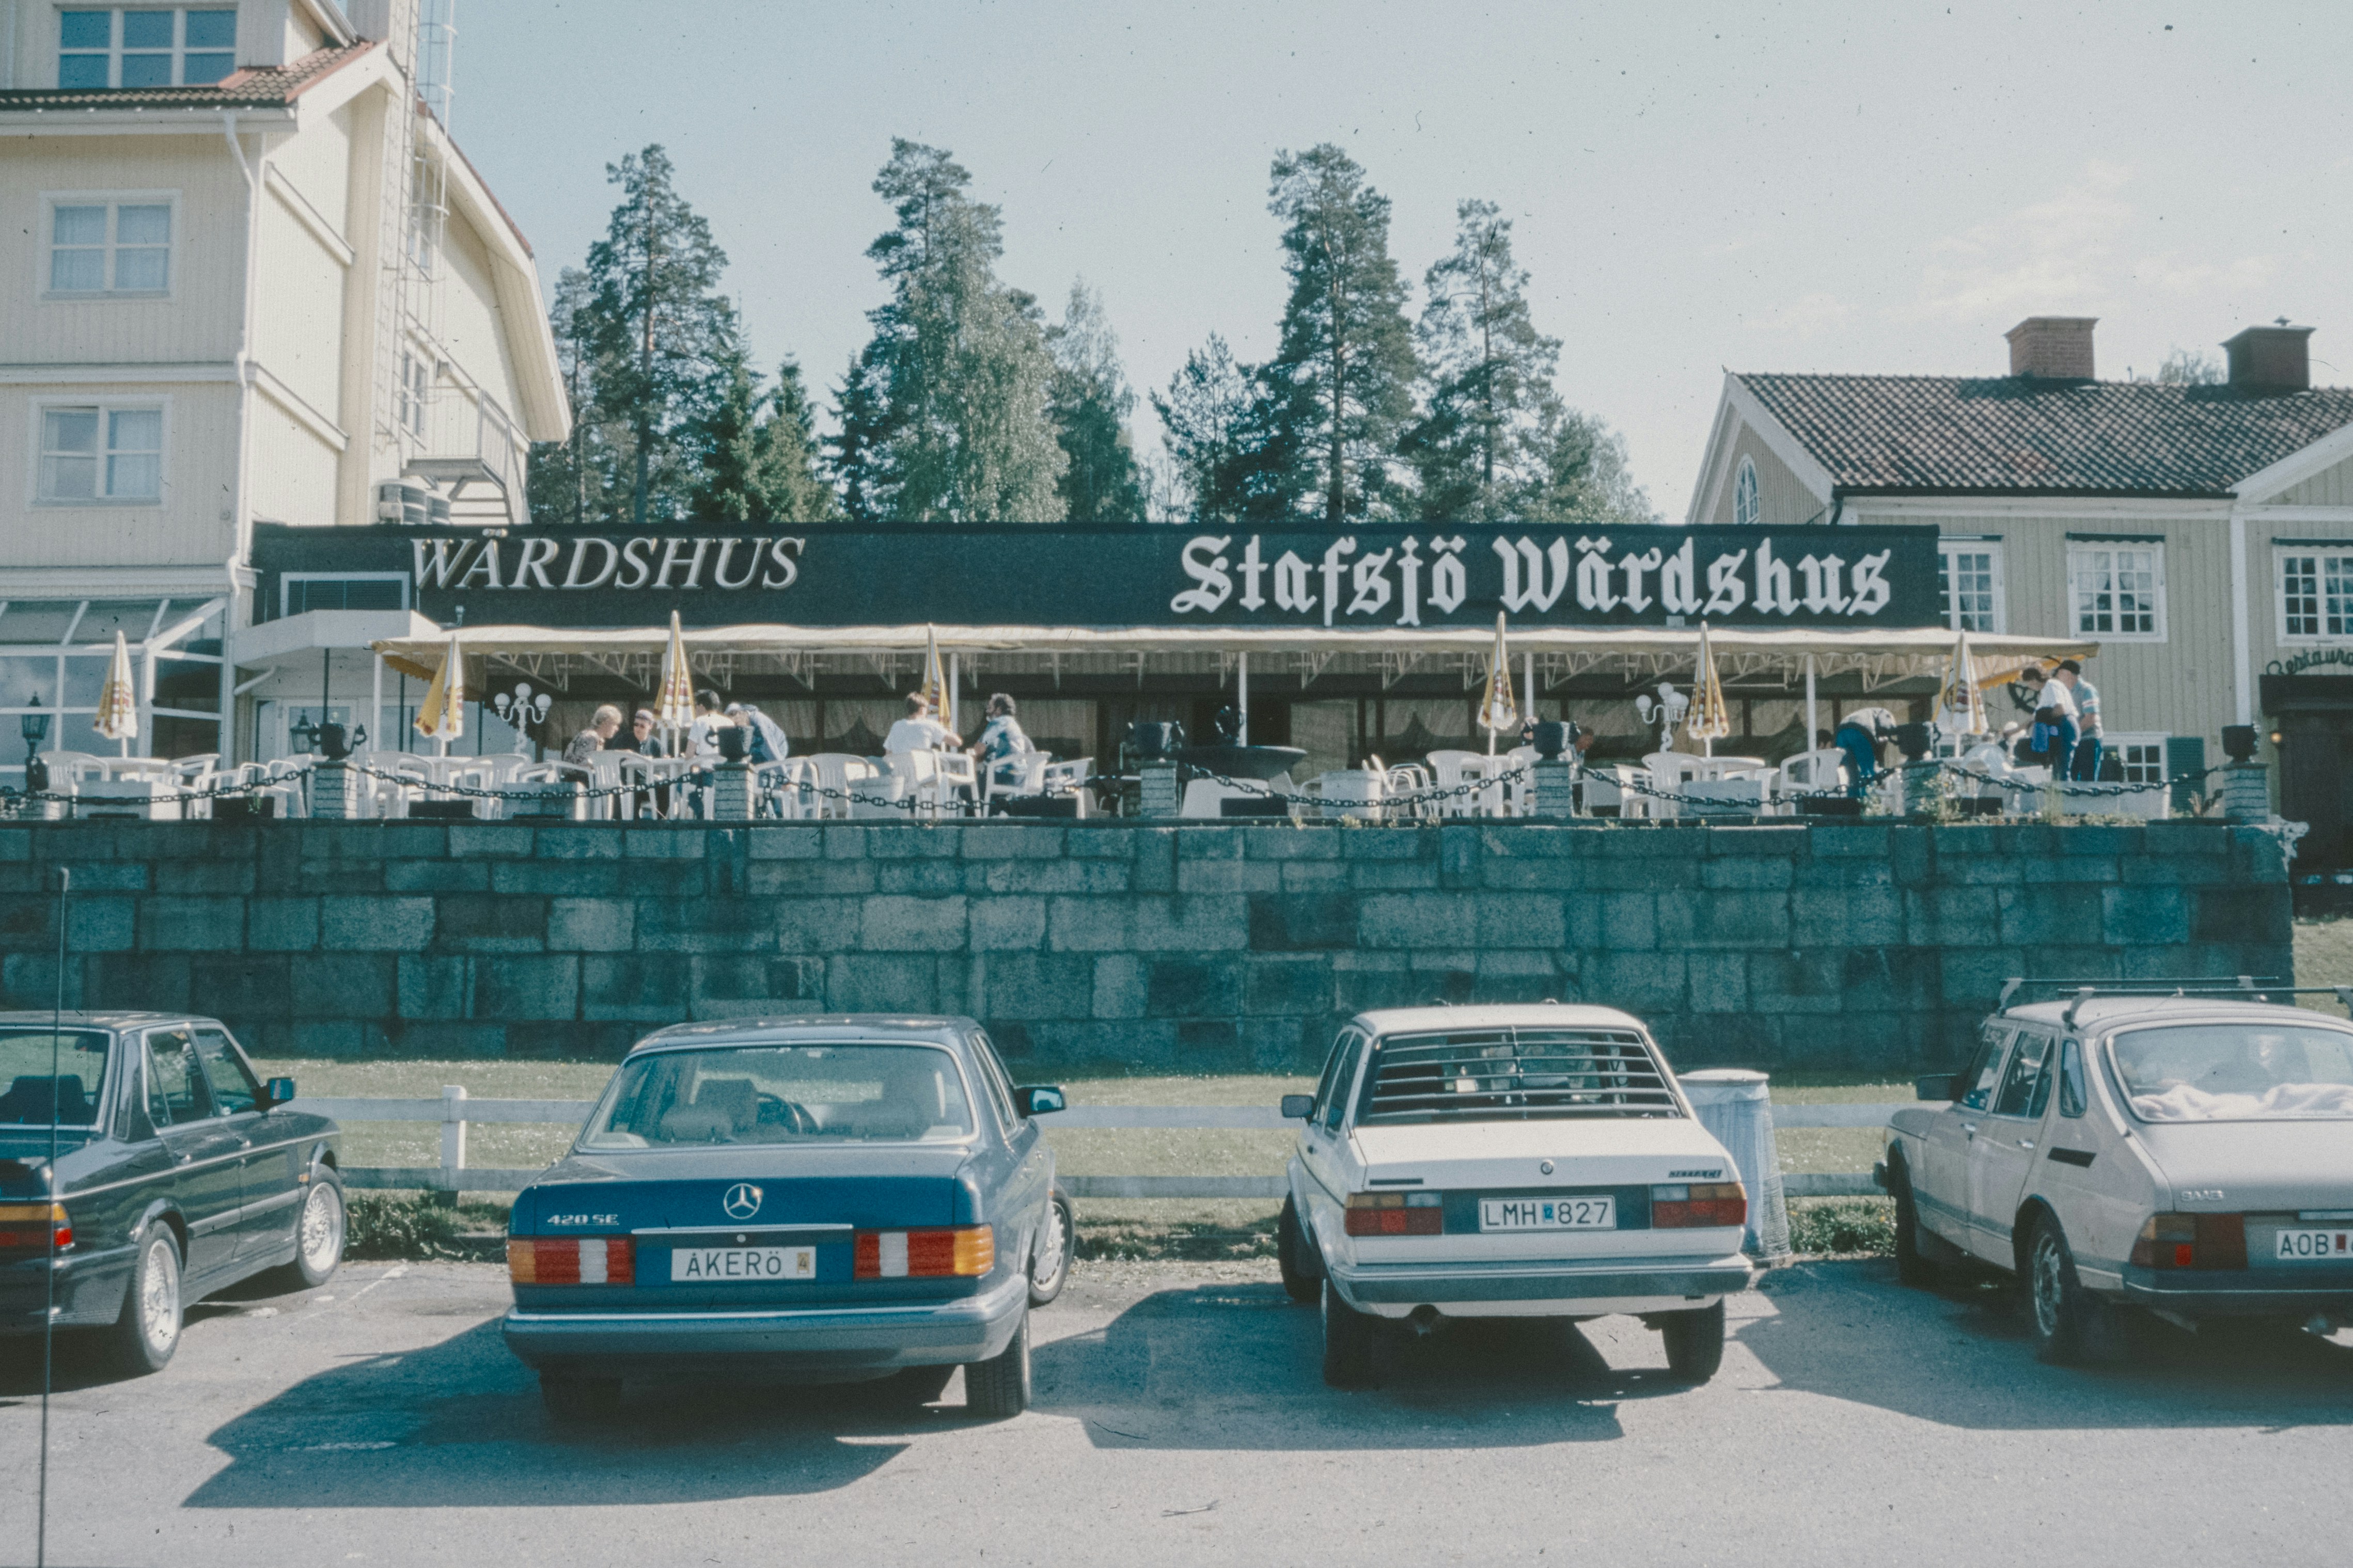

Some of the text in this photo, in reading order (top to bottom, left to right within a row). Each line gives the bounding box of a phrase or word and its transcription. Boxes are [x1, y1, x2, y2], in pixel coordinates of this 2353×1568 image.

[410, 528, 806, 590] WÄRDSHUS
[1170, 535, 1891, 626] Stafsjö Wärdshus
[2181, 1190, 2224, 1201] SAAB
[547, 1214, 618, 1225] 420 SE
[1485, 1203, 1536, 1226] LMH
[1558, 1202, 1608, 1224] 827
[2280, 1233, 2329, 1256] AOB
[686, 1251, 781, 1276] ÅKERÖ
